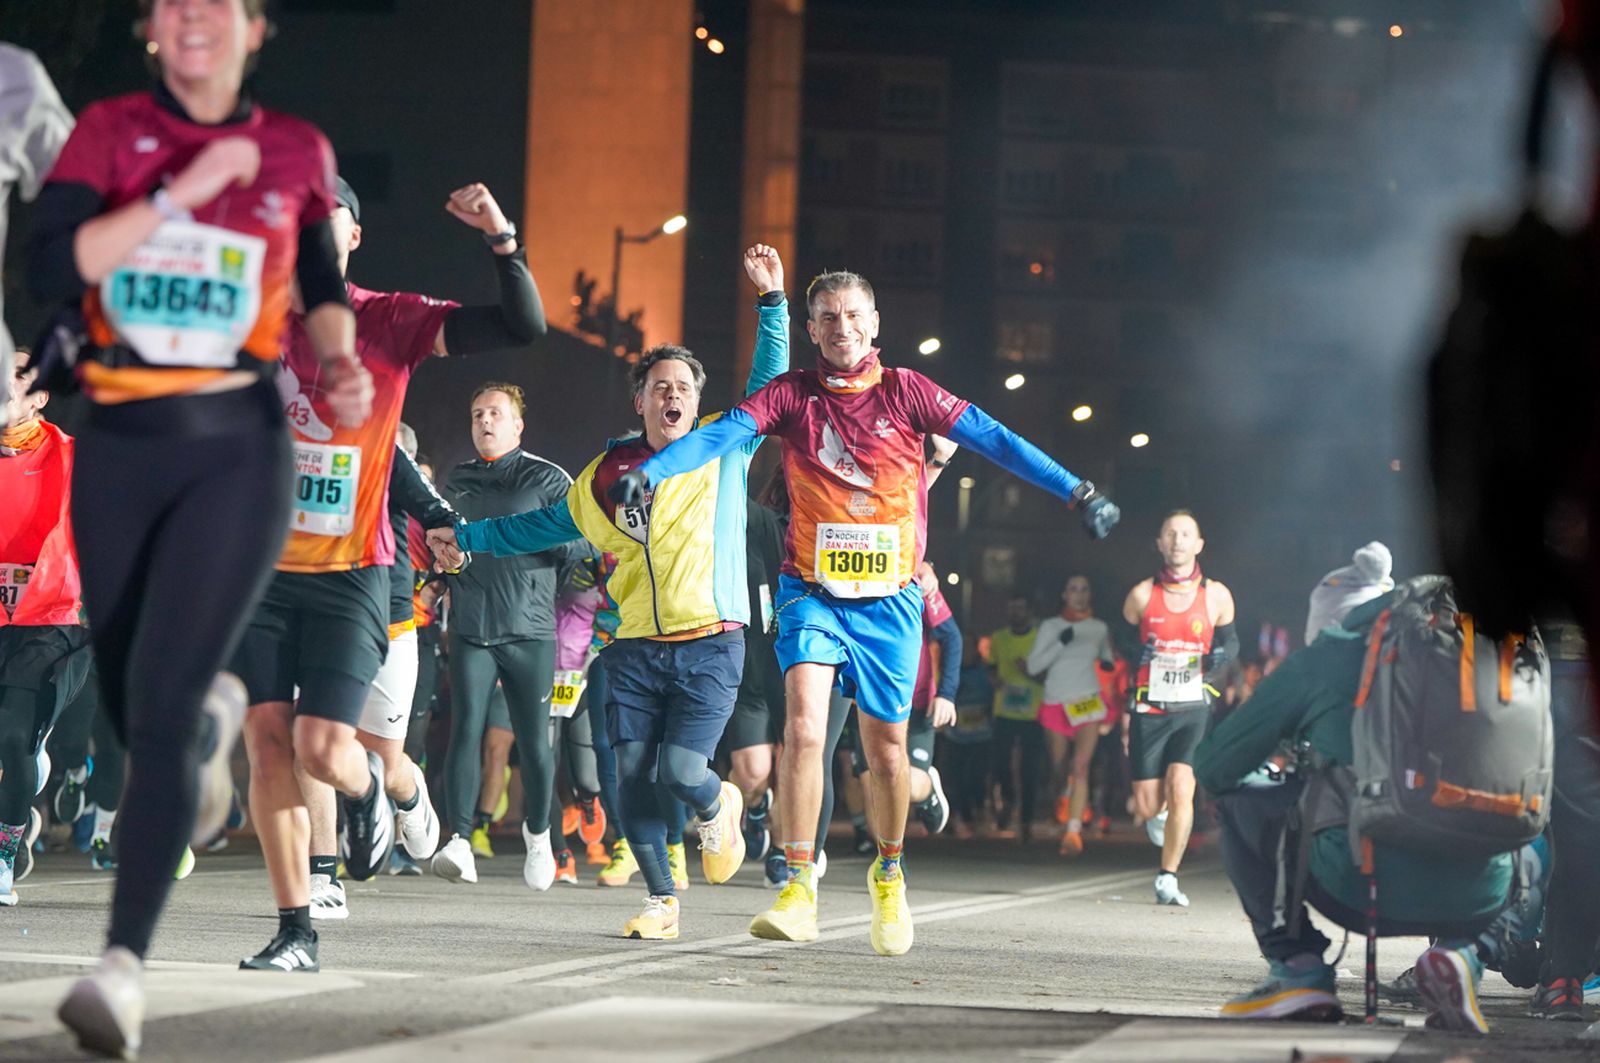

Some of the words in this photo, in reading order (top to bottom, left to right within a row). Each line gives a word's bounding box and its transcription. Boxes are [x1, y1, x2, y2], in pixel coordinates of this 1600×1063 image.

[119, 271, 239, 320] 13643
[285, 400, 310, 426] 43
[834, 457, 856, 477] 43
[825, 541, 841, 550] SAN
[835, 532, 859, 541] NOCHE
[860, 533, 870, 541] DE
[827, 551, 888, 574] 13019
[0, 585, 18, 605] 87
[1162, 670, 1191, 685] 4716
